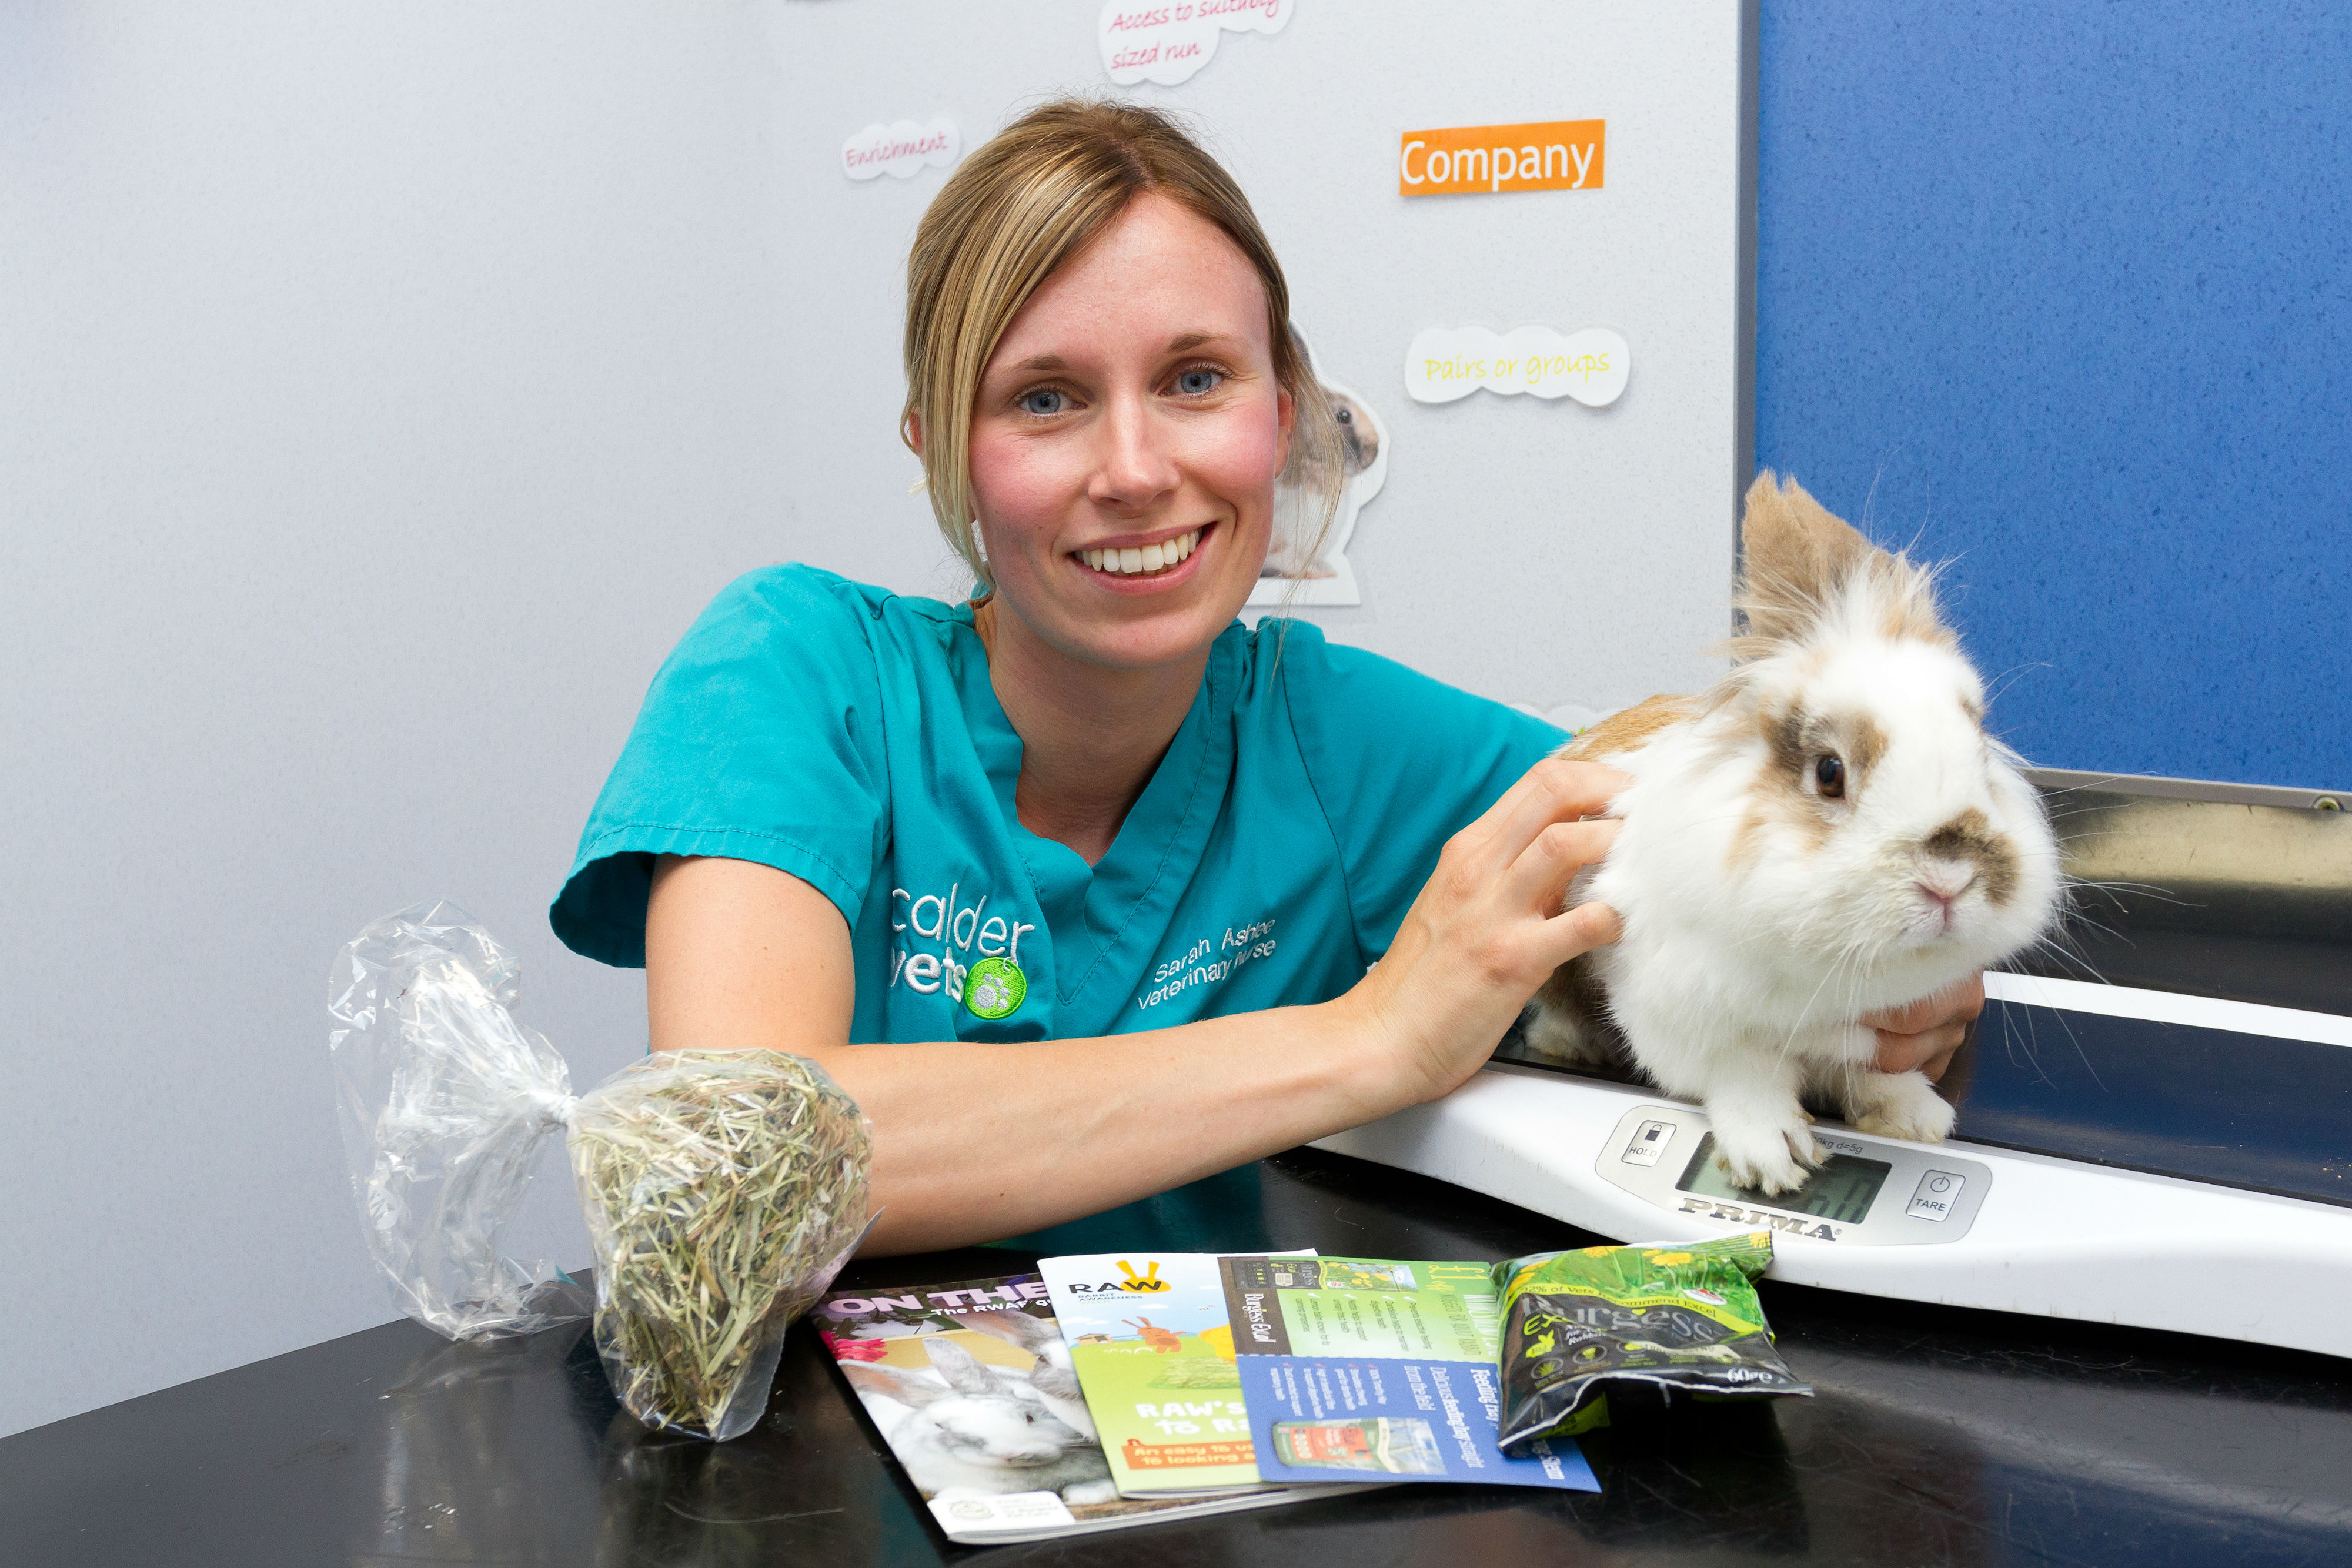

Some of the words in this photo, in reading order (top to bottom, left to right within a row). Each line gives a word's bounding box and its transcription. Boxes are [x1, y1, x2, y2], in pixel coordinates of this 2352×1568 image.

[1108, 8, 1170, 32] Access
[1175, 2, 1193, 21] to
[1111, 40, 1161, 69] sized
[1165, 42, 1201, 61] run
[845, 131, 949, 168] Enrichment
[1401, 141, 1596, 192] Company
[1424, 354, 1487, 380] Pairs
[1495, 359, 1519, 378] or
[1526, 353, 1611, 384] groups
[1154, 938, 1211, 984] Sarah
[1628, 1146, 1658, 1158] HOLD
[1916, 1198, 1947, 1212] TARE
[1068, 1281, 1162, 1294] RAW
[1568, 1286, 1594, 1294] Vets
[1683, 1300, 1716, 1318] Excel
[828, 1295, 924, 1313] ON
[931, 1308, 968, 1316] The
[1242, 1293, 1265, 1322] Burgess
[1251, 1323, 1277, 1342] Excel
[1404, 1365, 1422, 1382] from
[1470, 1369, 1498, 1404] Feeding
[1430, 1366, 1454, 1399] Delicious
[1442, 1399, 1465, 1426] feeding
[1135, 1447, 1159, 1456] An
[1164, 1446, 1207, 1456] easy
[1210, 1444, 1231, 1453] to
[1142, 1457, 1163, 1465] to
[1167, 1453, 1239, 1465] looking
